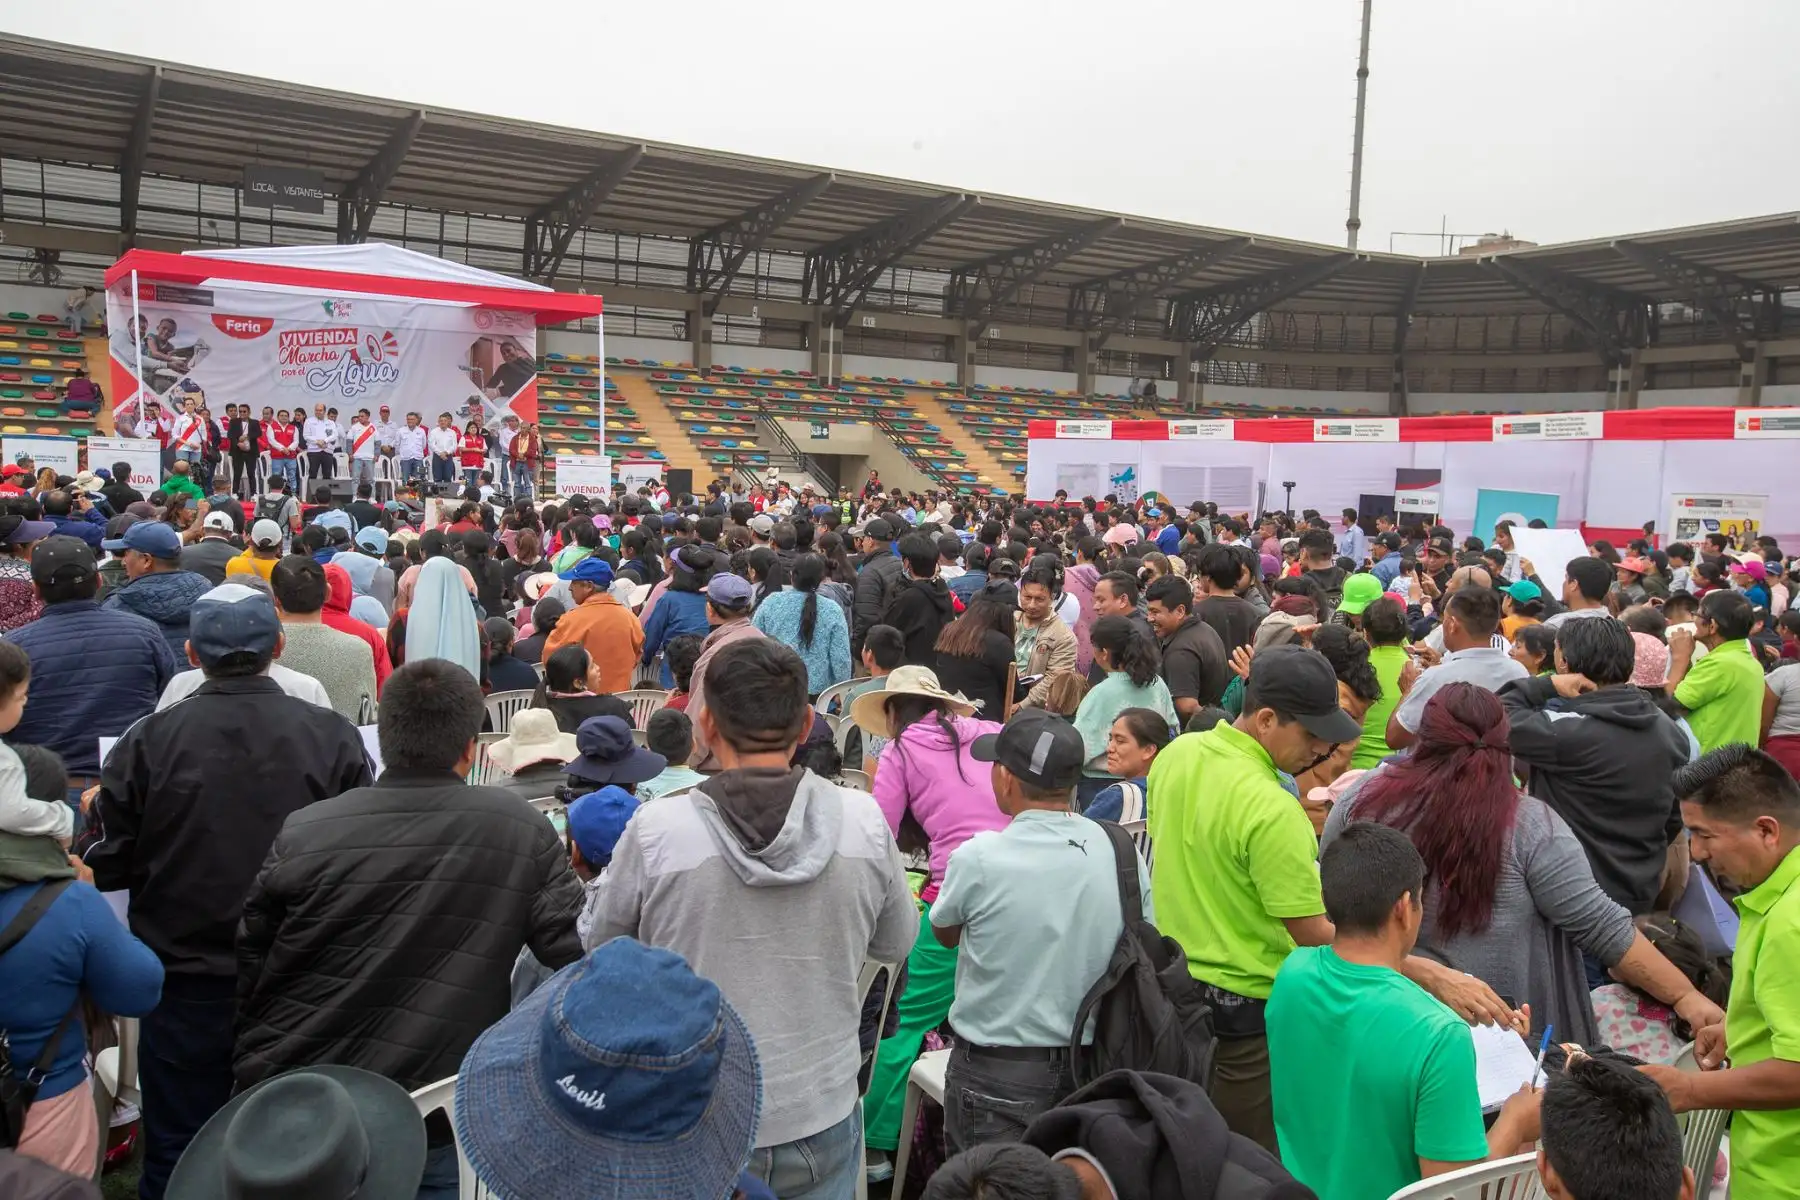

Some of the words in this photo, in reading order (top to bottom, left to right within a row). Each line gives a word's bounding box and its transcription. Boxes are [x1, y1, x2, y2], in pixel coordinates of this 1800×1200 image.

[252, 181, 278, 194] LOCAL
[284, 186, 324, 199] VISITANTES
[226, 319, 261, 333] Feria
[281, 330, 357, 346] VIVIENDA
[279, 345, 340, 365] Marcha
[281, 368, 296, 378] por
[296, 366, 306, 376] el
[306, 350, 399, 397] Agua
[562, 485, 606, 495] VIVIENDA
